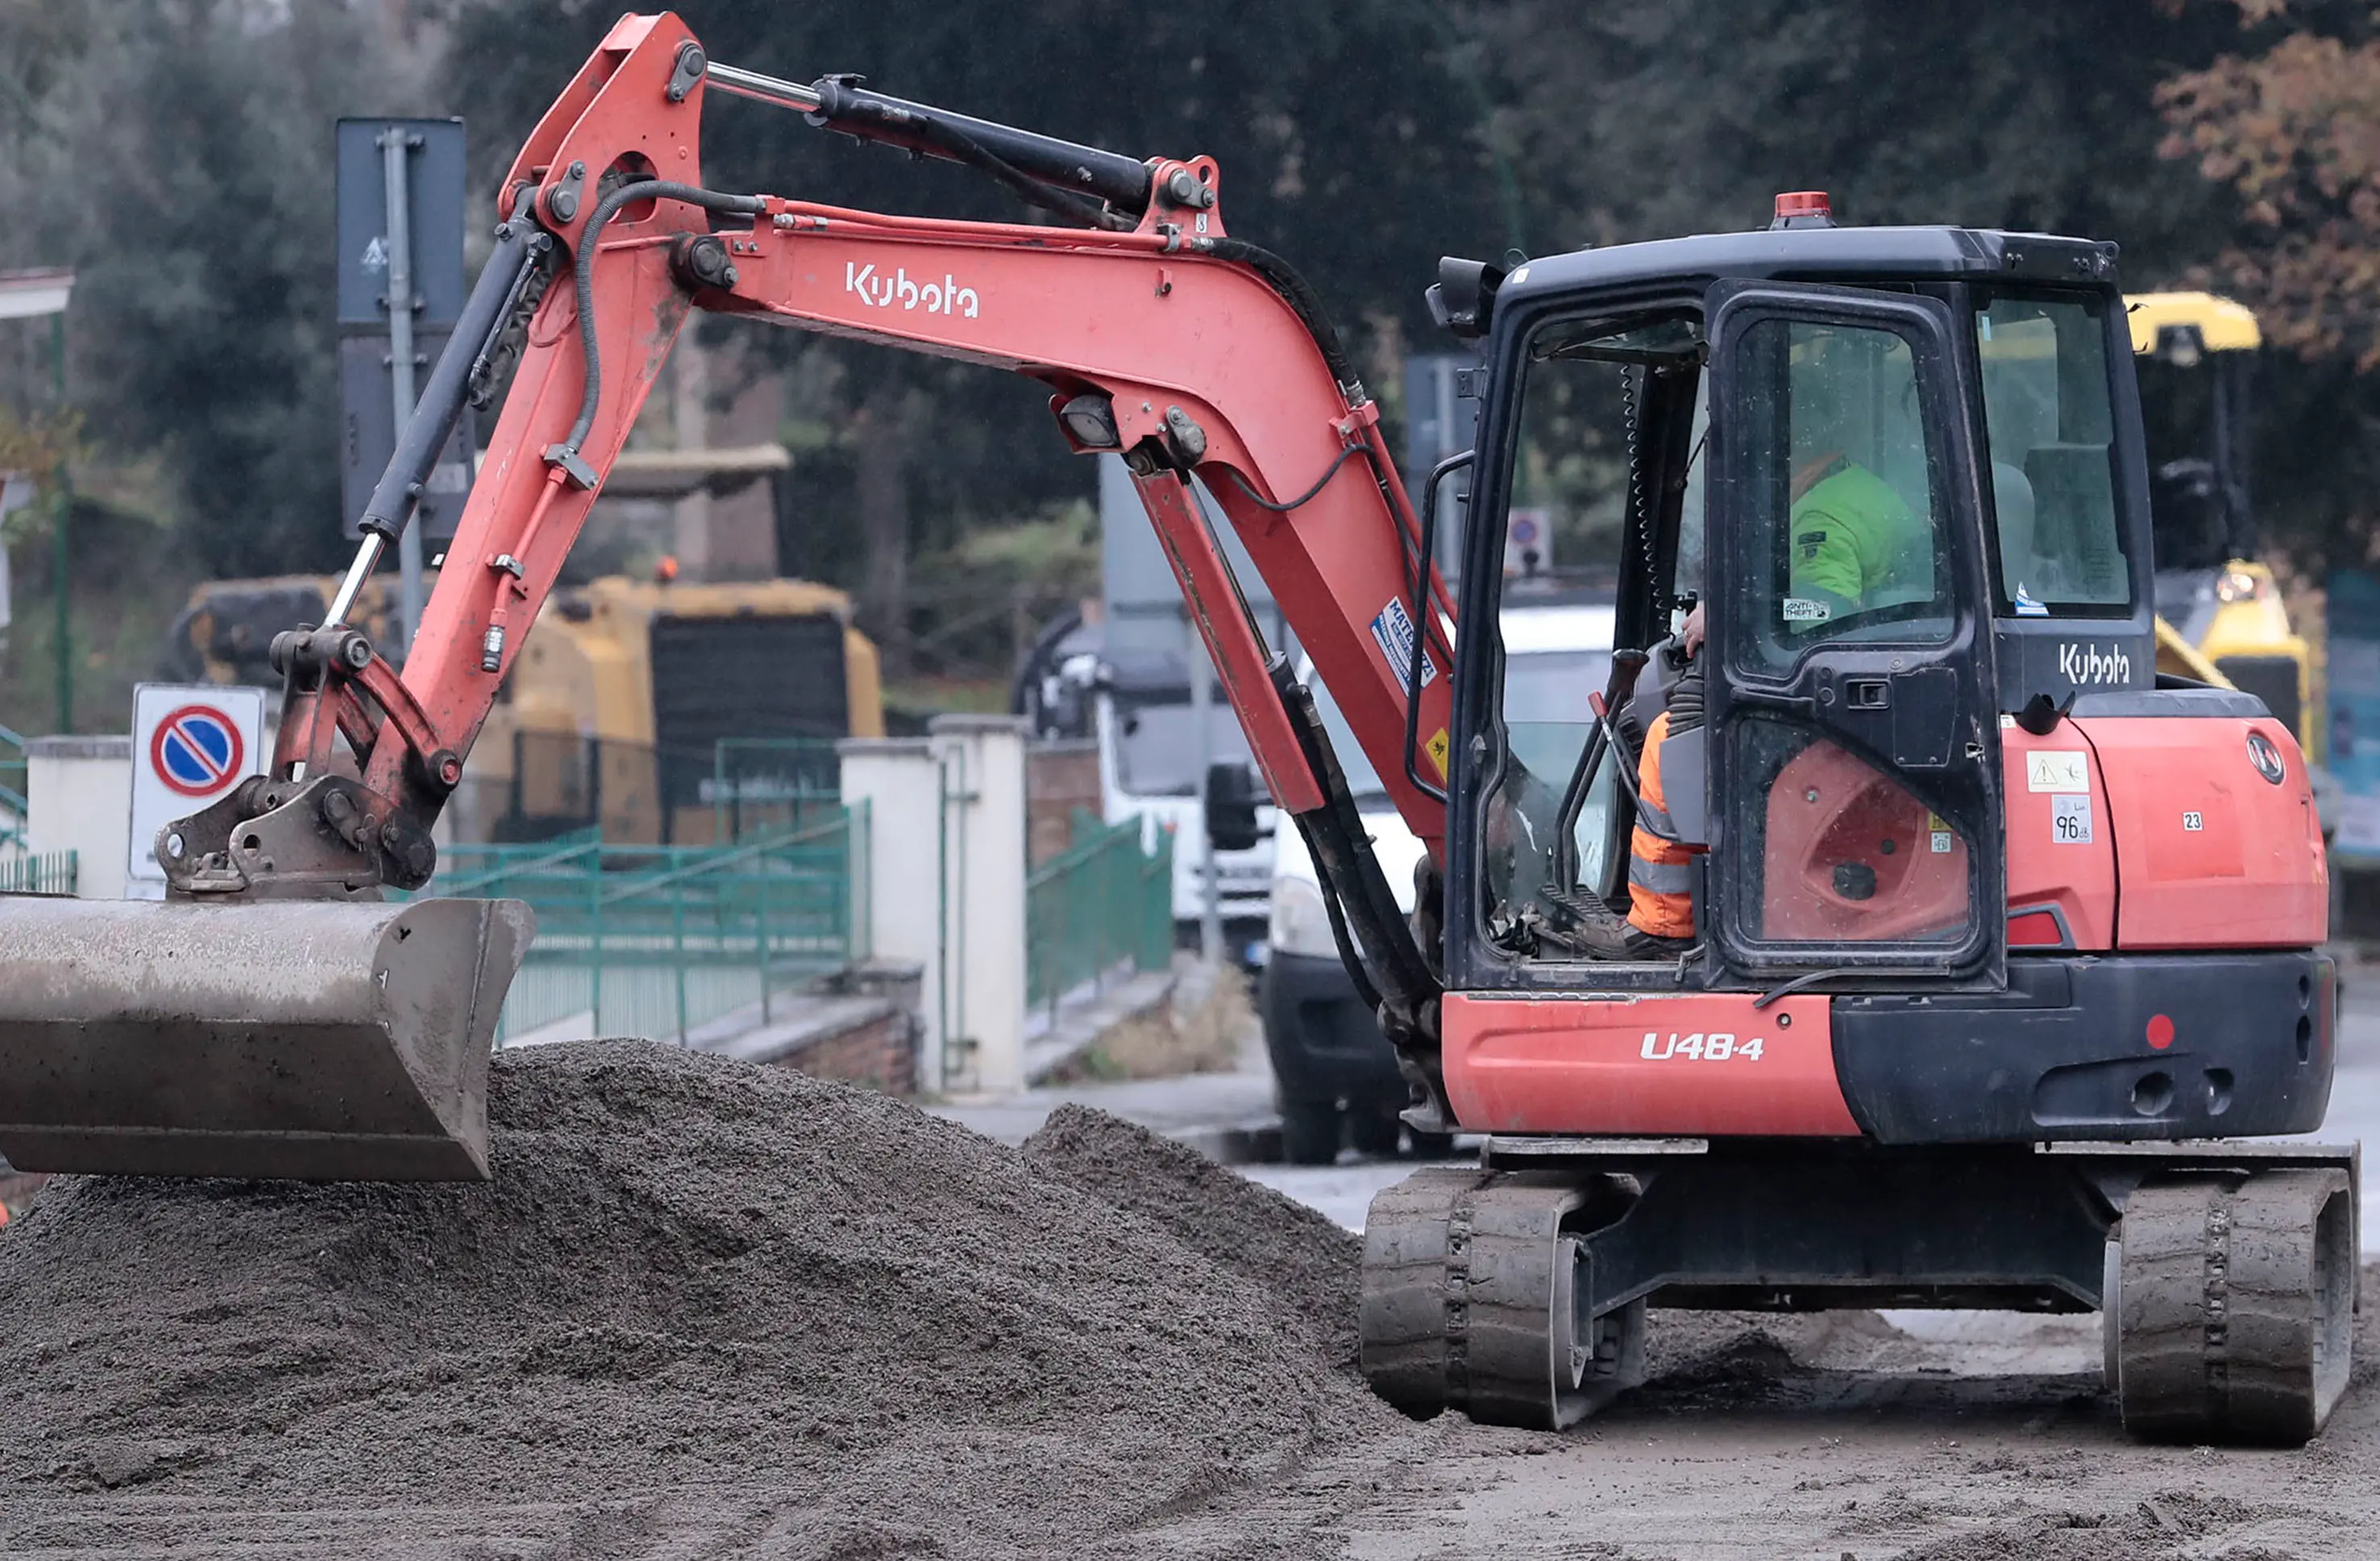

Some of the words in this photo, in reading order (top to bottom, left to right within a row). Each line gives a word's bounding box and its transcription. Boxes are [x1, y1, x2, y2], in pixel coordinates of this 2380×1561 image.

[845, 261, 979, 318] Kubota
[2059, 643, 2130, 684] Kubota
[2056, 816, 2079, 839] 96
[2185, 814, 2200, 828] 23
[1639, 1032, 1764, 1061] U48-4
